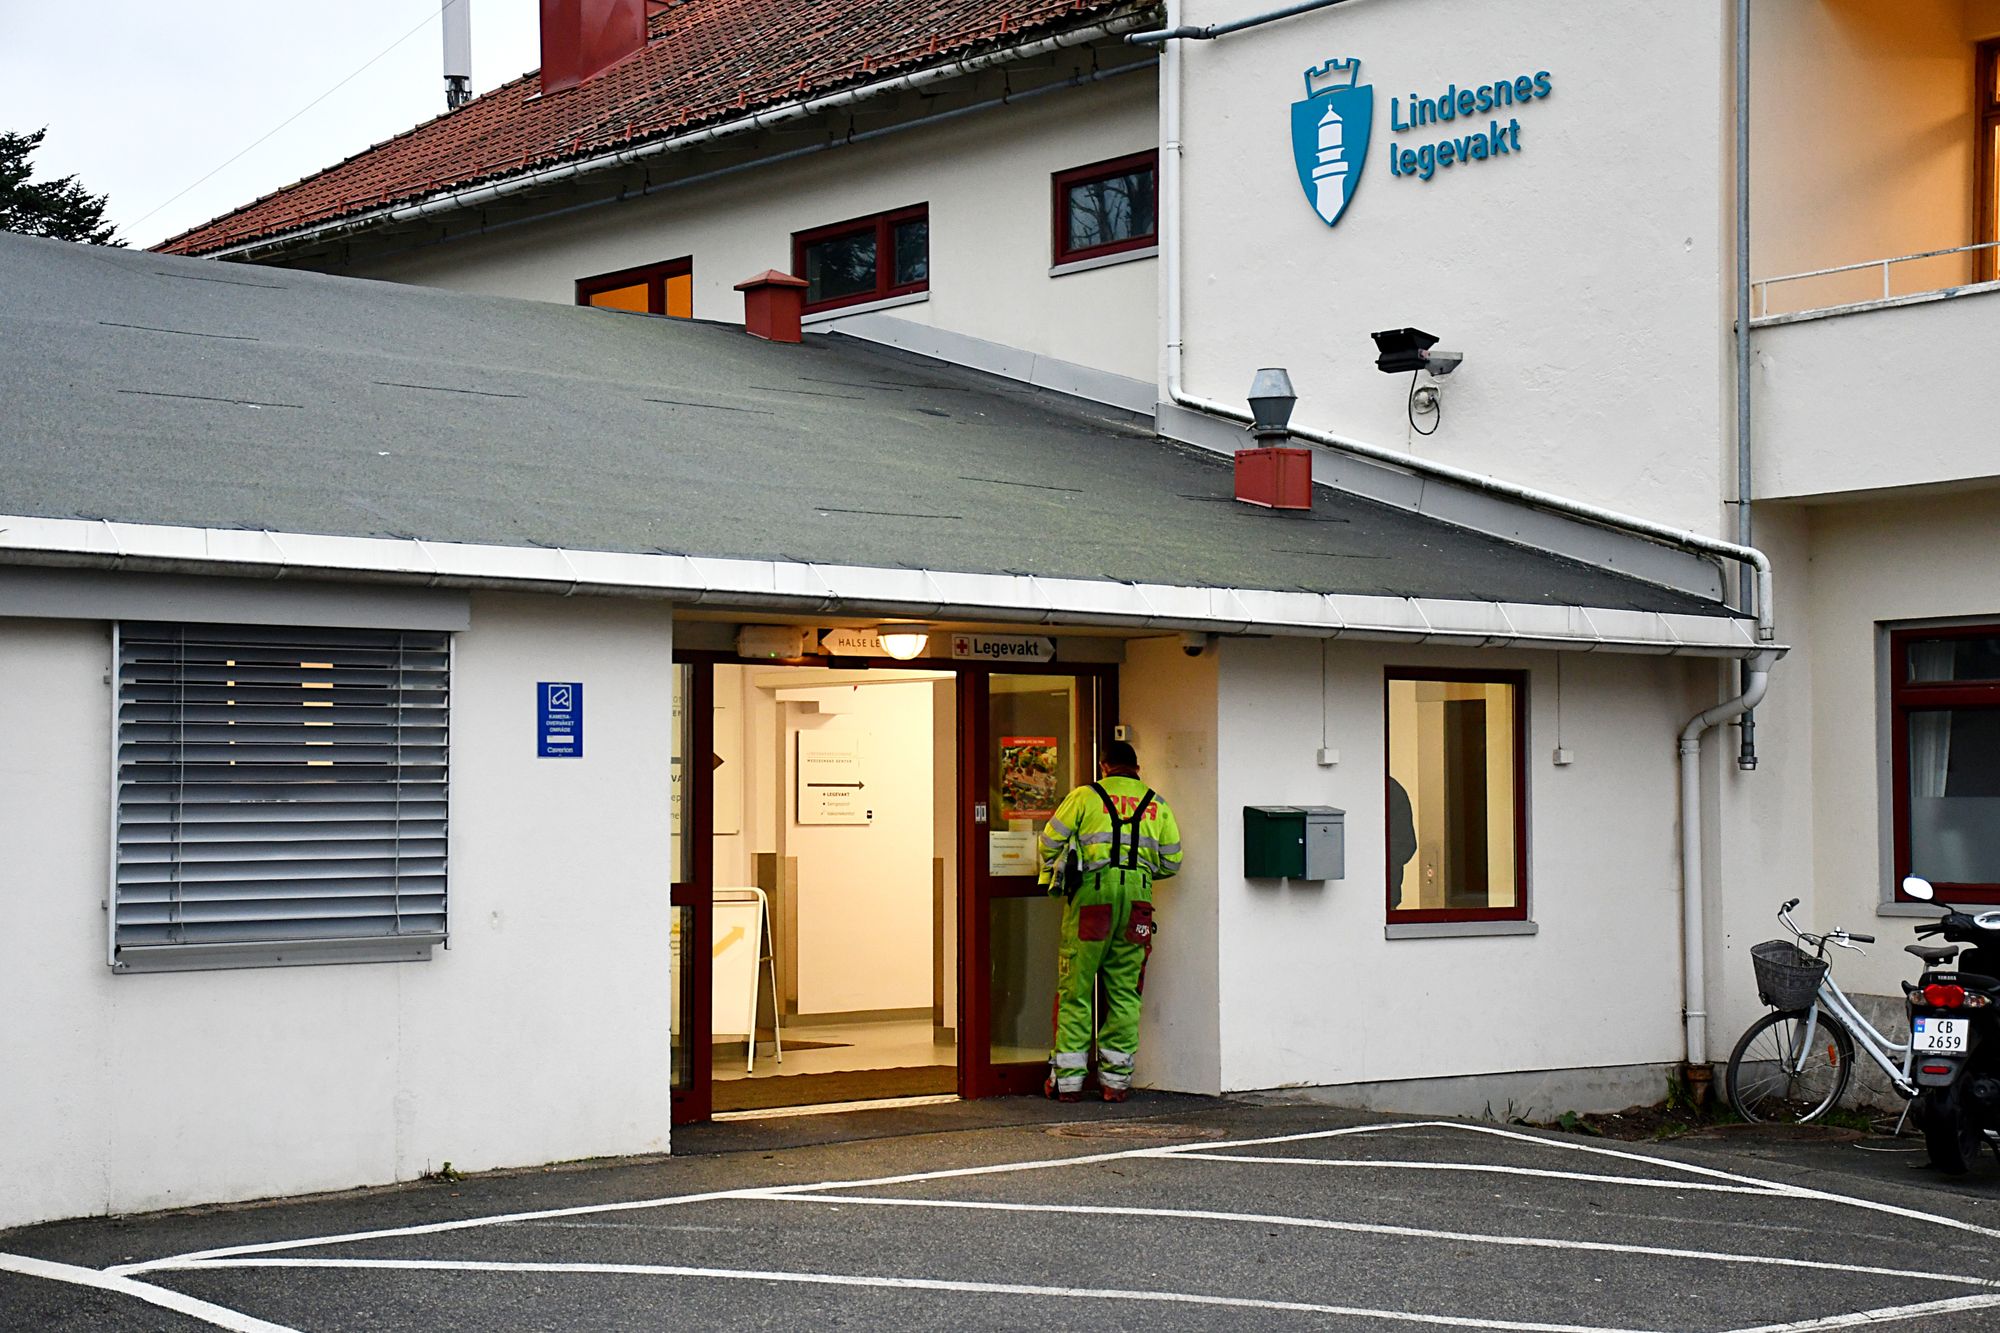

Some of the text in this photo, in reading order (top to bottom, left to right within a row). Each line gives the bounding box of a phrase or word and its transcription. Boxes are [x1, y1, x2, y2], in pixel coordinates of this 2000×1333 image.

[1391, 70, 1552, 132] Lindesnes
[1390, 118, 1521, 181] legevakt
[838, 638, 867, 648] HALSE
[973, 638, 1040, 659] Legevakt
[547, 746, 574, 754] Caverion
[1937, 1020, 1953, 1034] CB
[1928, 1035, 1961, 1049] 2659
